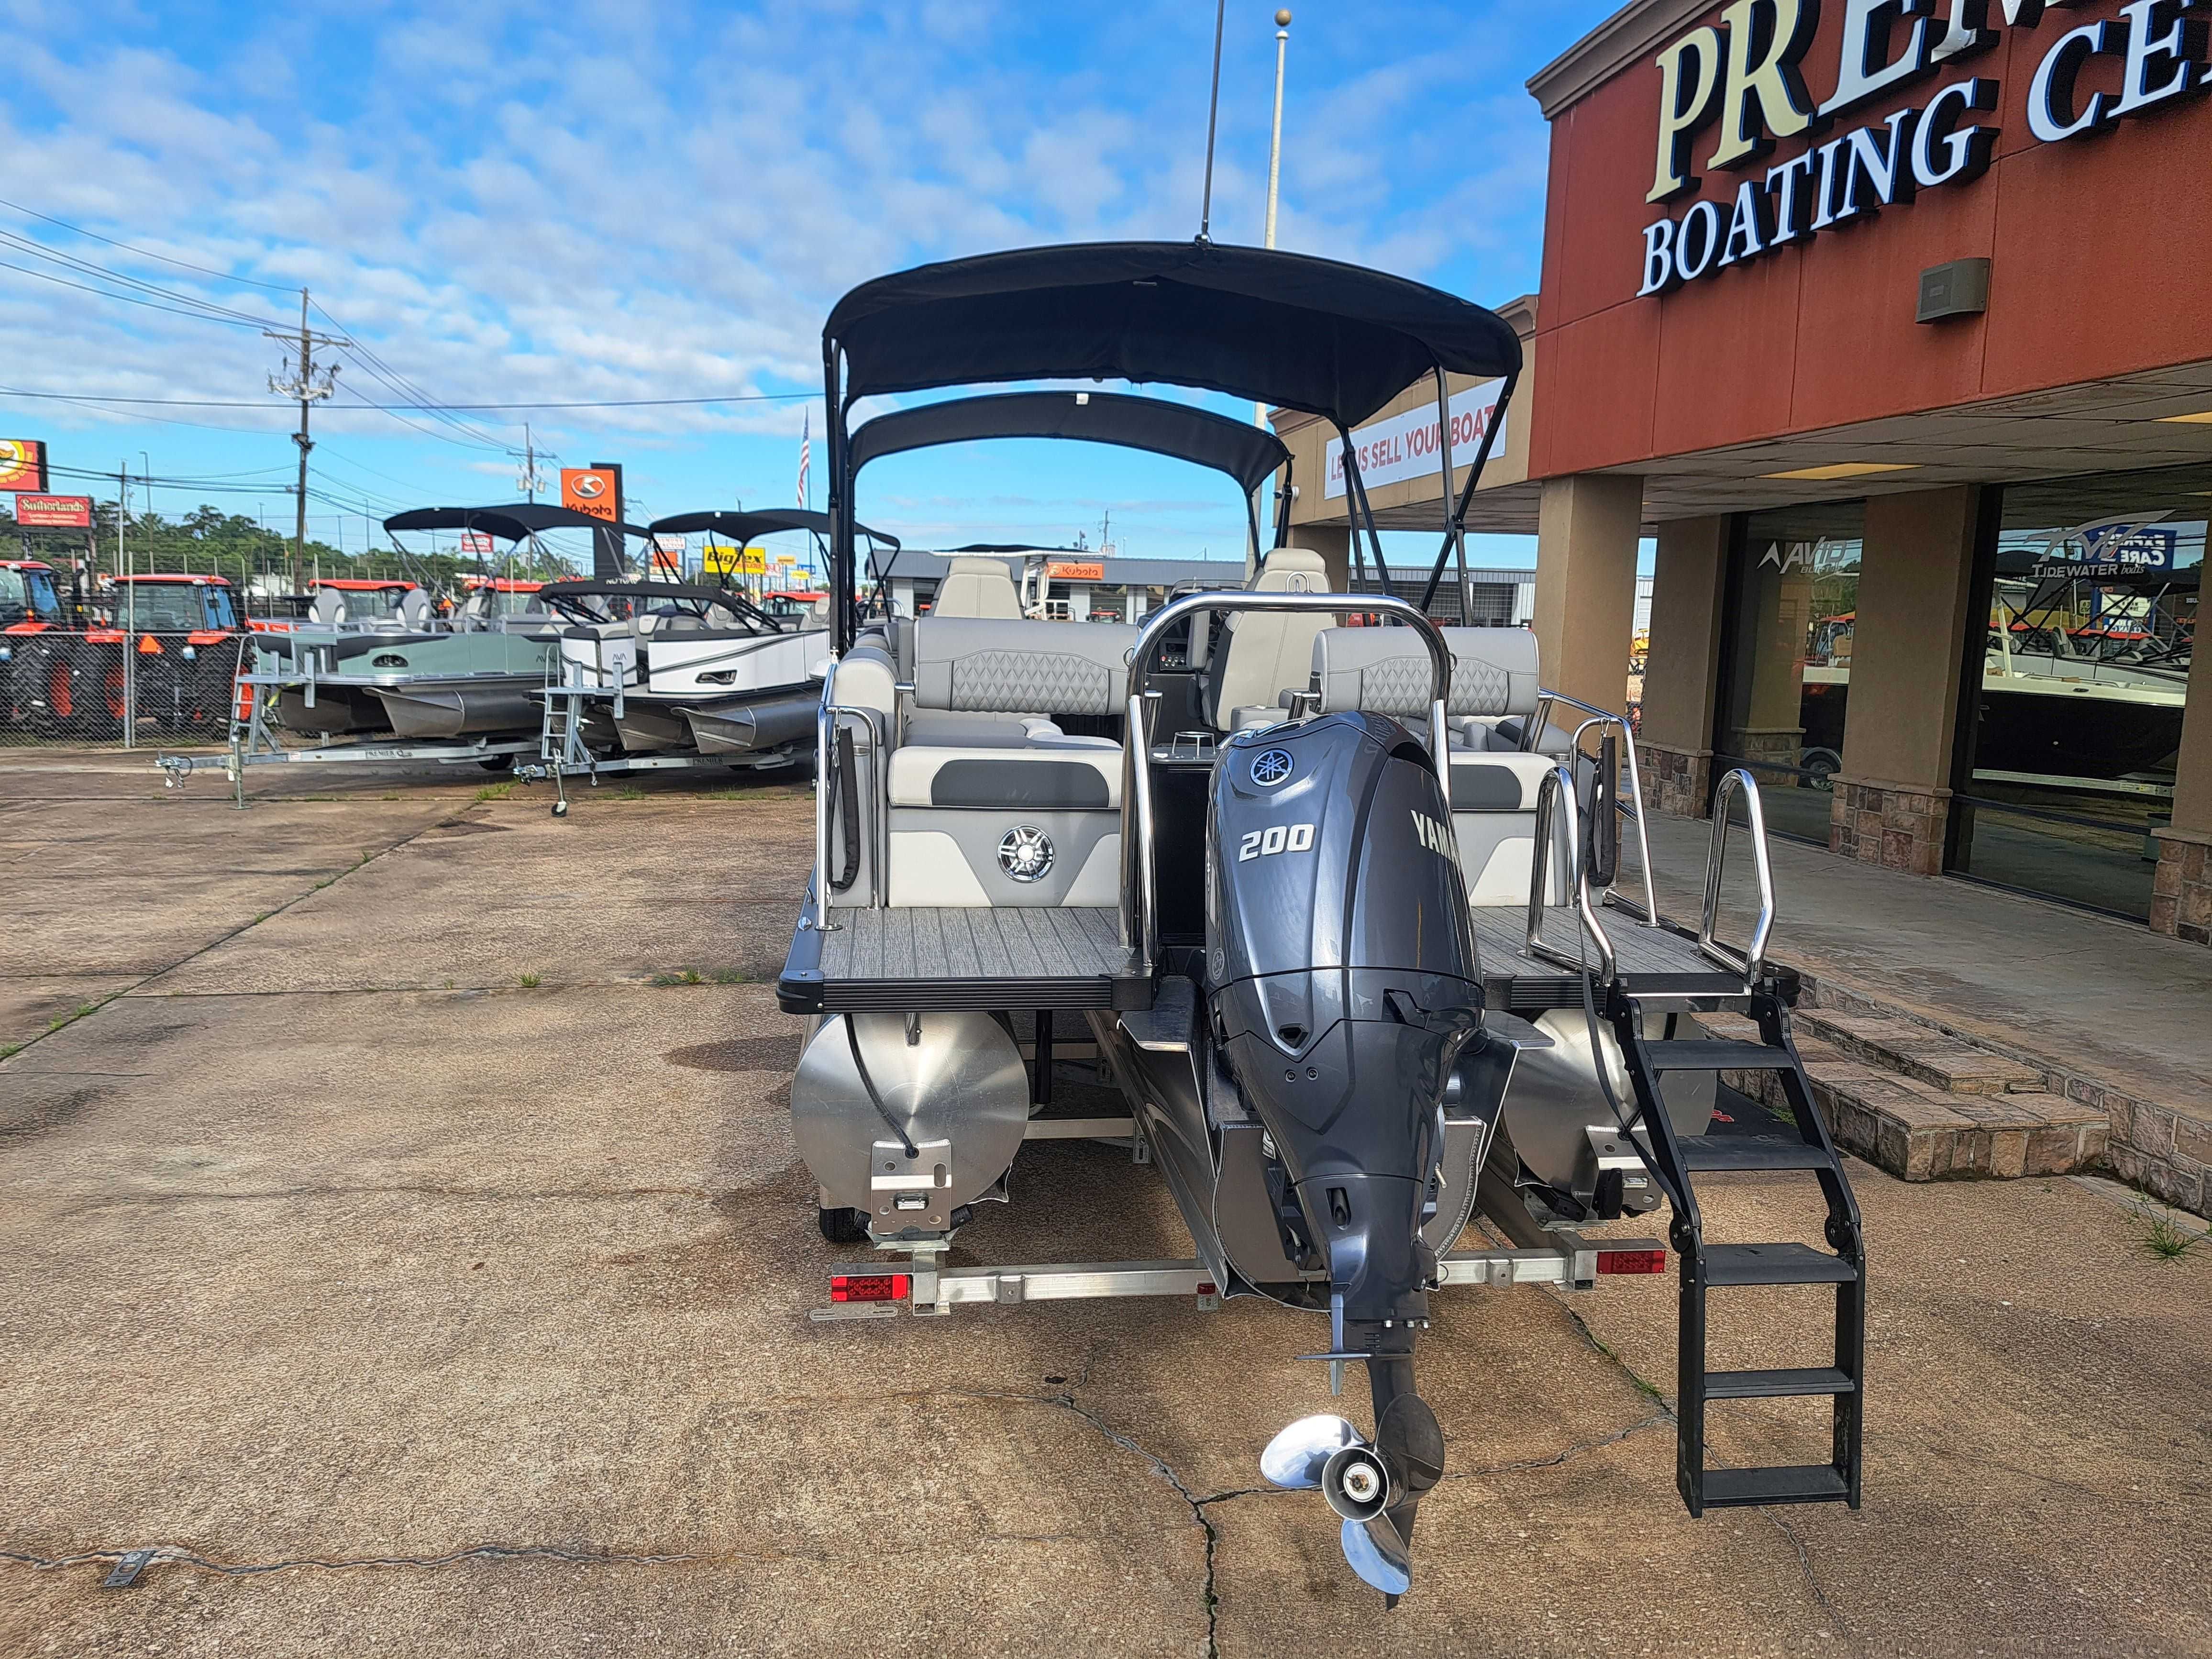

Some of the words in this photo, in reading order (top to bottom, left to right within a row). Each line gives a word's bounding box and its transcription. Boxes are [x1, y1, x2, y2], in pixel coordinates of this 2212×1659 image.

[1636, 77, 1979, 297] BOATING
[2027, 0, 2212, 142] CE
[1331, 454, 1343, 481] LE
[1358, 446, 1368, 472] S
[1371, 436, 1402, 469] SELL
[1062, 566, 1098, 575] Kubota
[2031, 564, 2118, 578] TIDEWATER
[1239, 824, 1316, 862] 200
